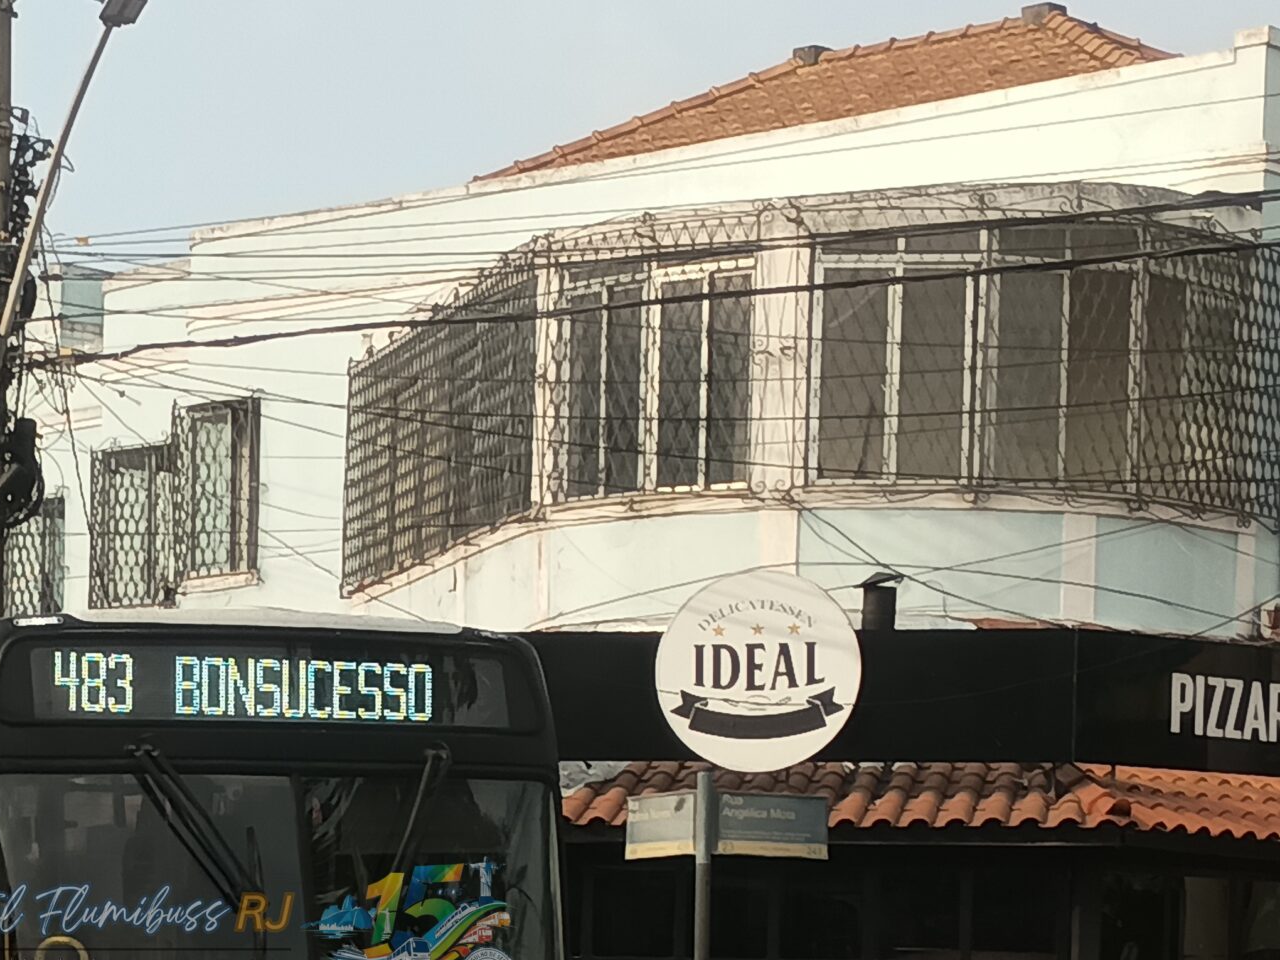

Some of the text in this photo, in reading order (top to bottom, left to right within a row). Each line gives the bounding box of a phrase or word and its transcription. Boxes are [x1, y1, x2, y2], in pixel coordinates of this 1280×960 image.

[697, 599, 817, 632] DELICATESSEN
[54, 651, 433, 721] 483 BONSUCESSO
[693, 641, 826, 692] IDEAL
